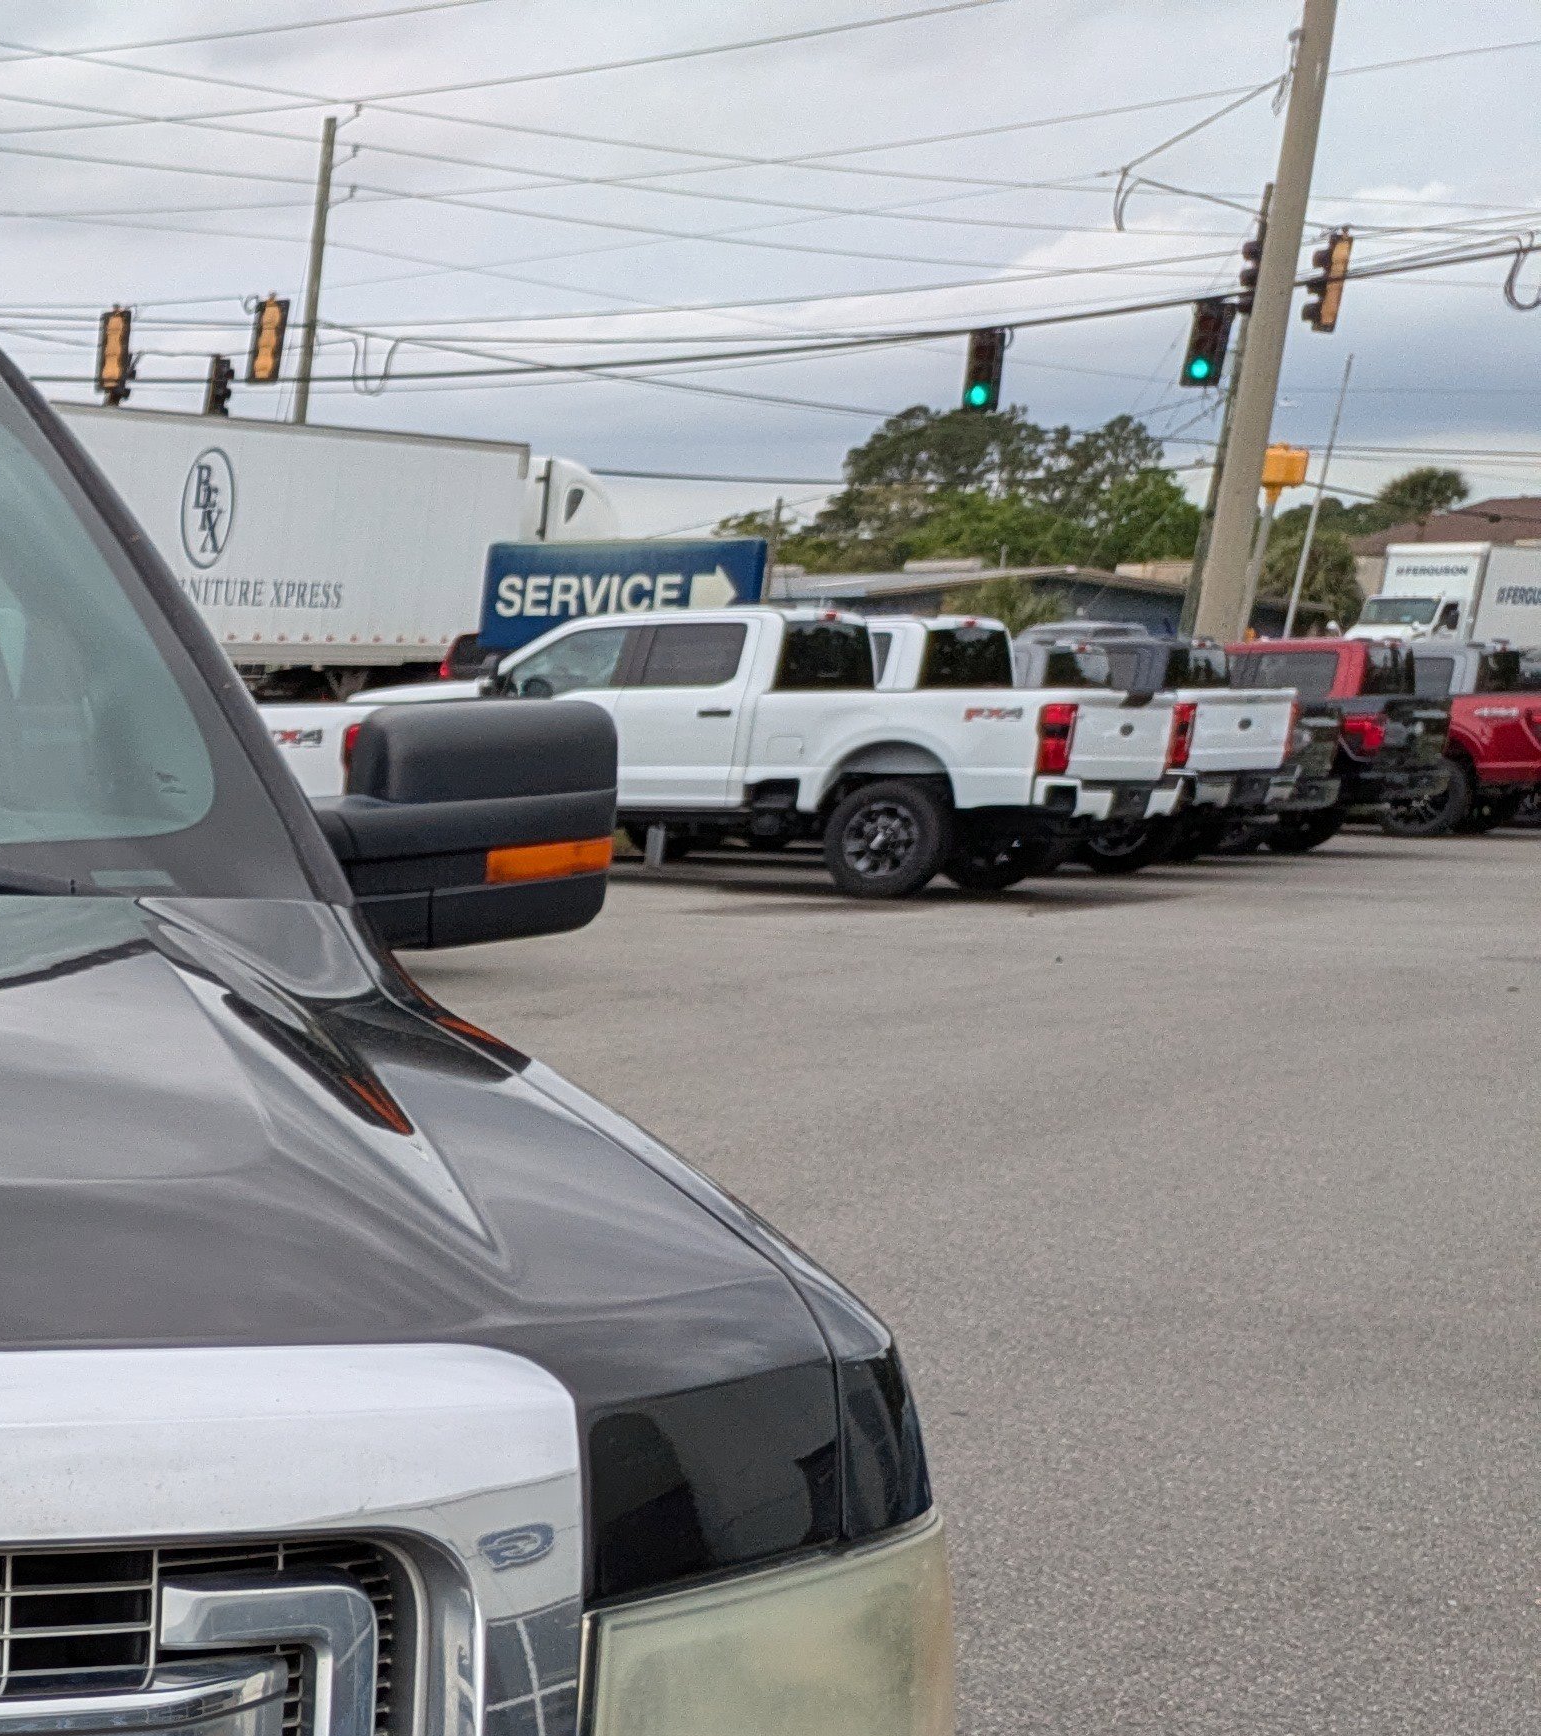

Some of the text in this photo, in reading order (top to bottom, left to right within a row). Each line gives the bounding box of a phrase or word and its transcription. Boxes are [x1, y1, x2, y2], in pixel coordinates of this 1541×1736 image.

[1406, 566, 1468, 576] FERGUSON
[269, 578, 344, 610] XPRESS
[495, 574, 683, 618] SERVICE
